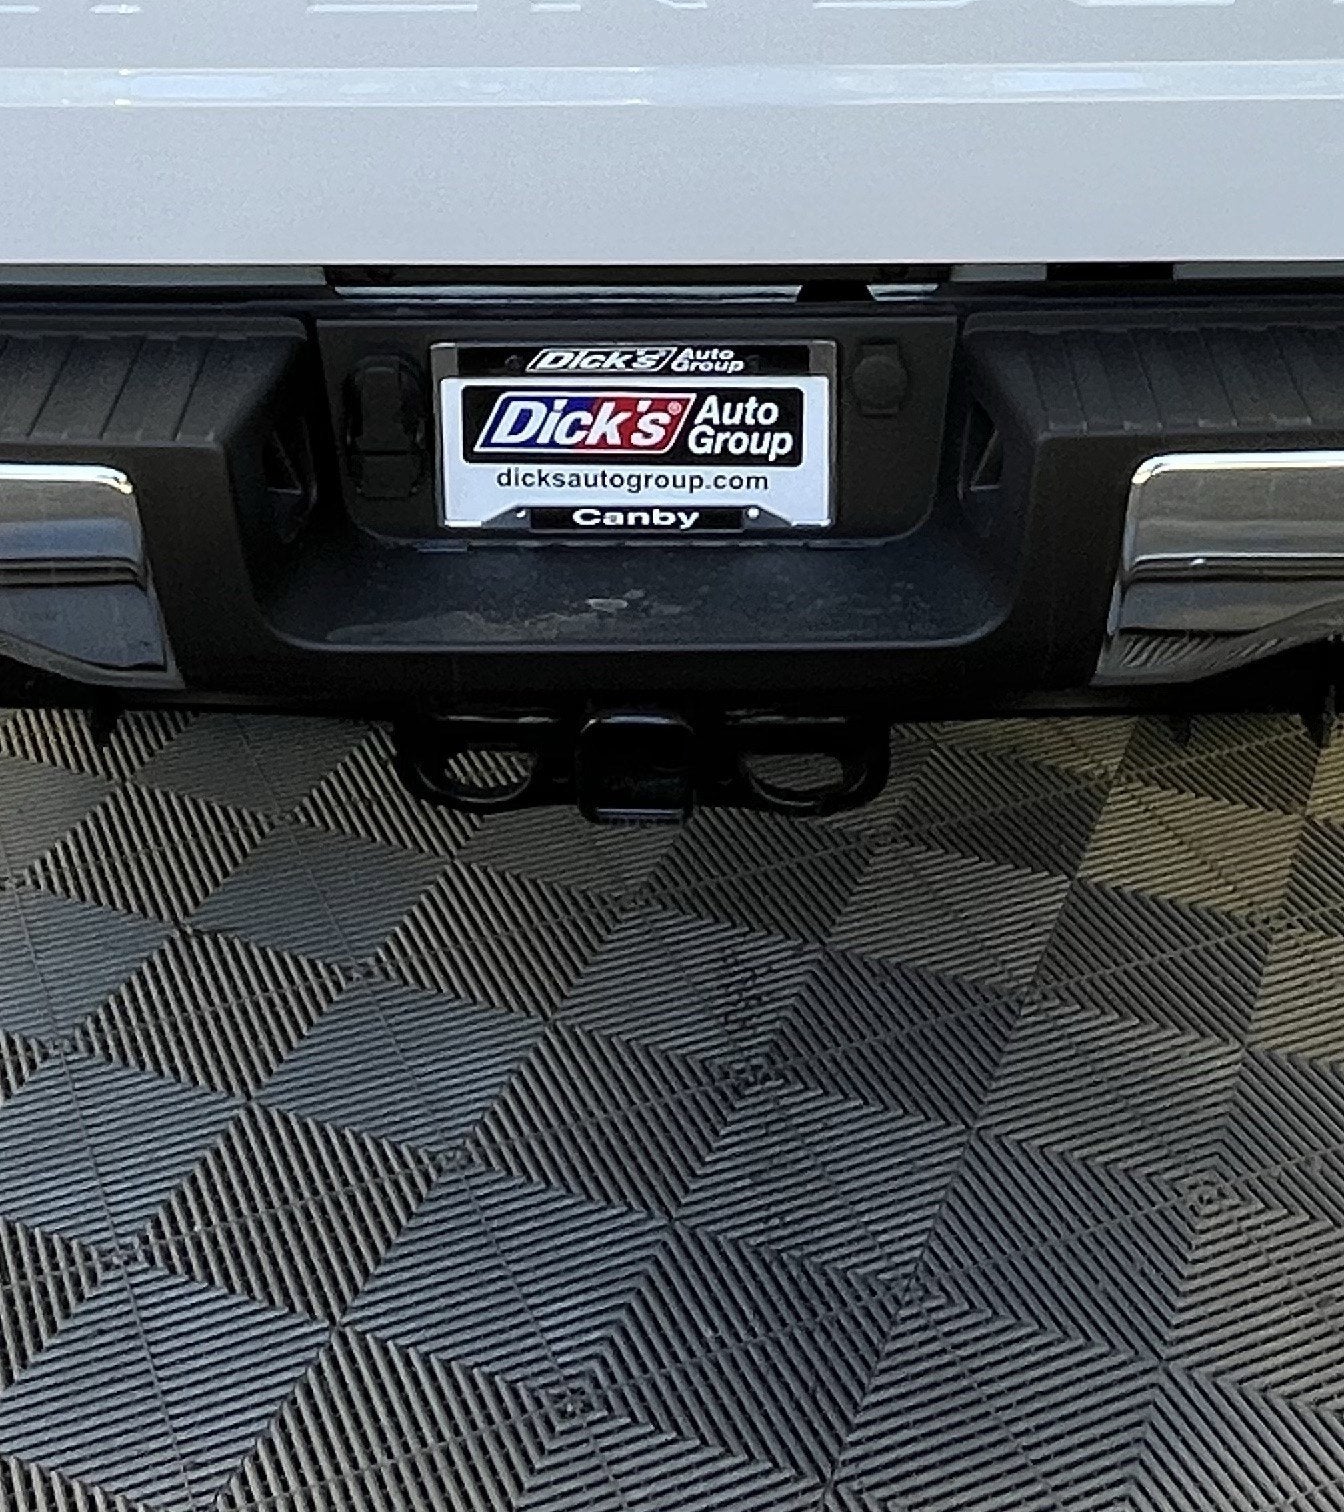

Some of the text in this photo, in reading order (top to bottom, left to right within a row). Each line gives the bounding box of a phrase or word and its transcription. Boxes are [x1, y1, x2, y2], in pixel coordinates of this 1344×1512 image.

[534, 348, 662, 370] Dick's
[673, 359, 743, 373] Group
[677, 348, 734, 361] Auto
[694, 395, 778, 425] Auto
[490, 399, 672, 447] Dick's
[688, 425, 793, 461] Group
[496, 468, 769, 492] dicksautogroup.com
[572, 509, 699, 529] Canby
